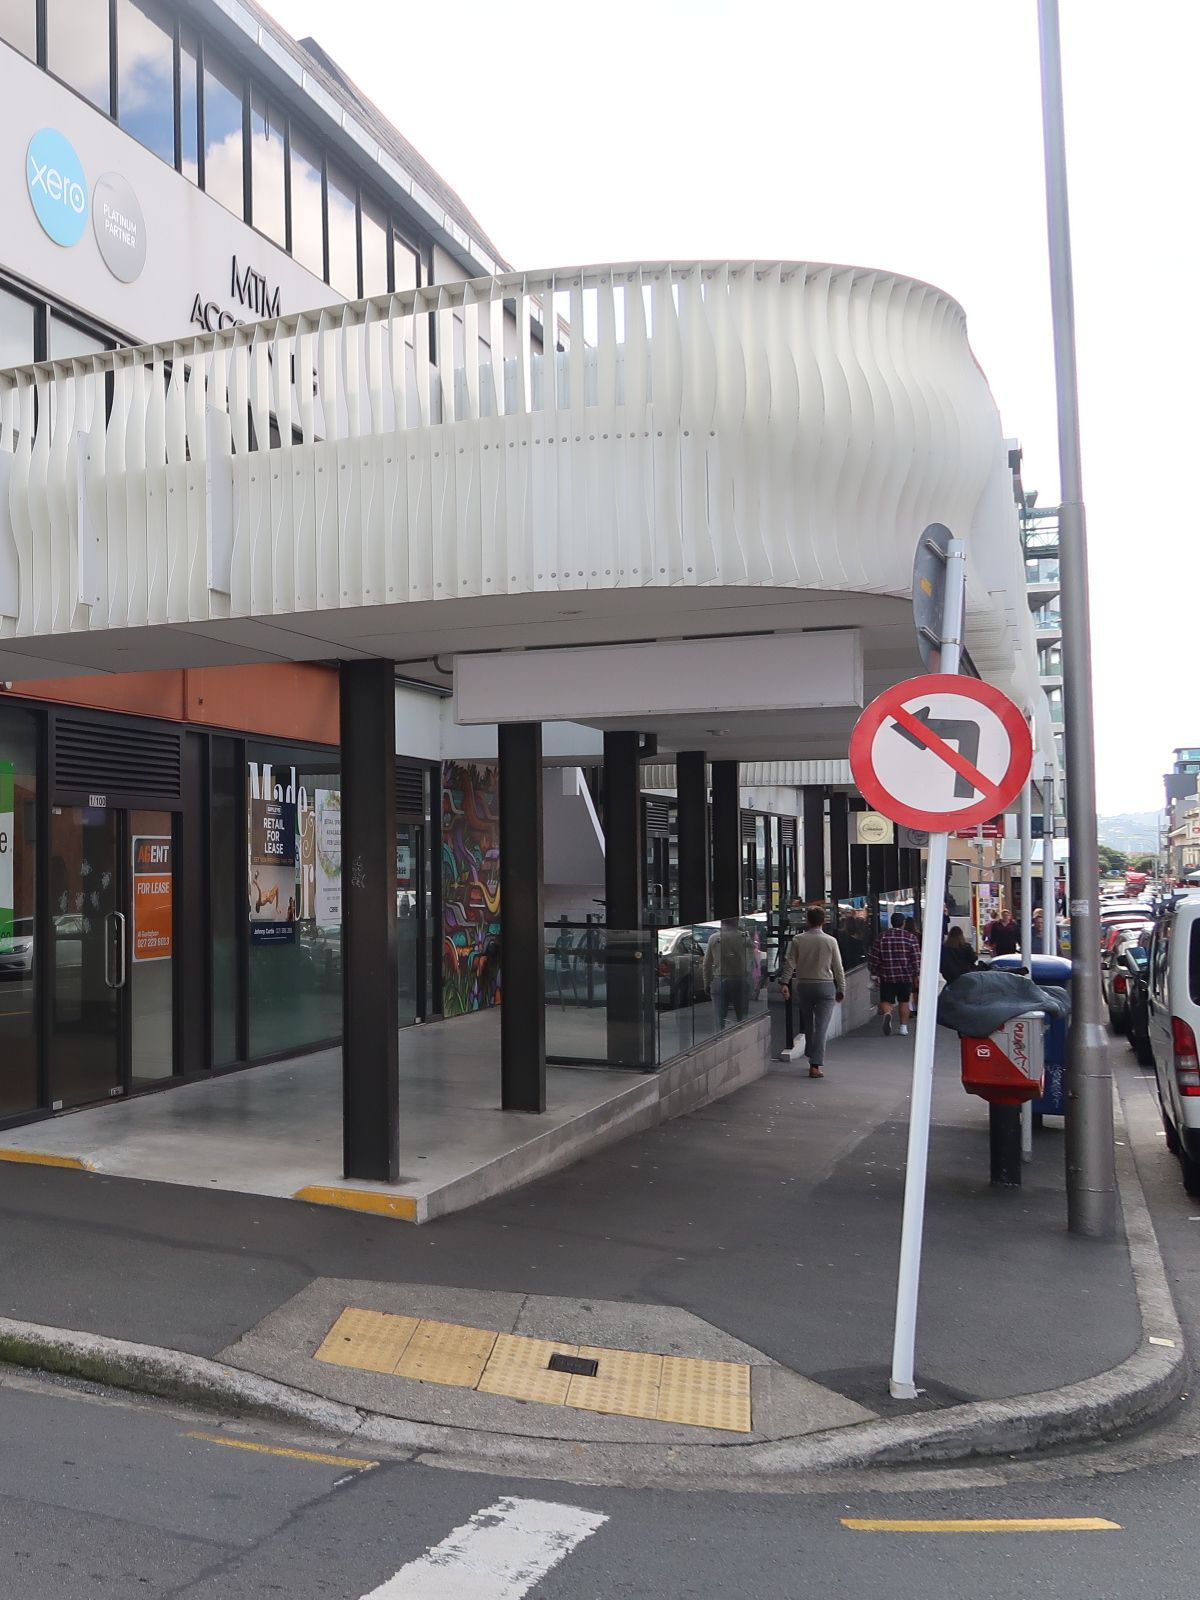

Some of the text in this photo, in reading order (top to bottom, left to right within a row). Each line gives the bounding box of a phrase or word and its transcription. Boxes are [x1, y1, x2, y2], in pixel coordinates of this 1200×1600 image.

[31, 155, 85, 214] xero
[103, 203, 137, 235] PLATINUM
[104, 219, 136, 249] PARTNER
[231, 255, 280, 319] MTM
[263, 817, 285, 830] RETAIL
[266, 830, 280, 842] FOR
[137, 845, 170, 863] AGENT
[264, 842, 284, 855] LEASE
[137, 881, 170, 894] FOR LEASE
